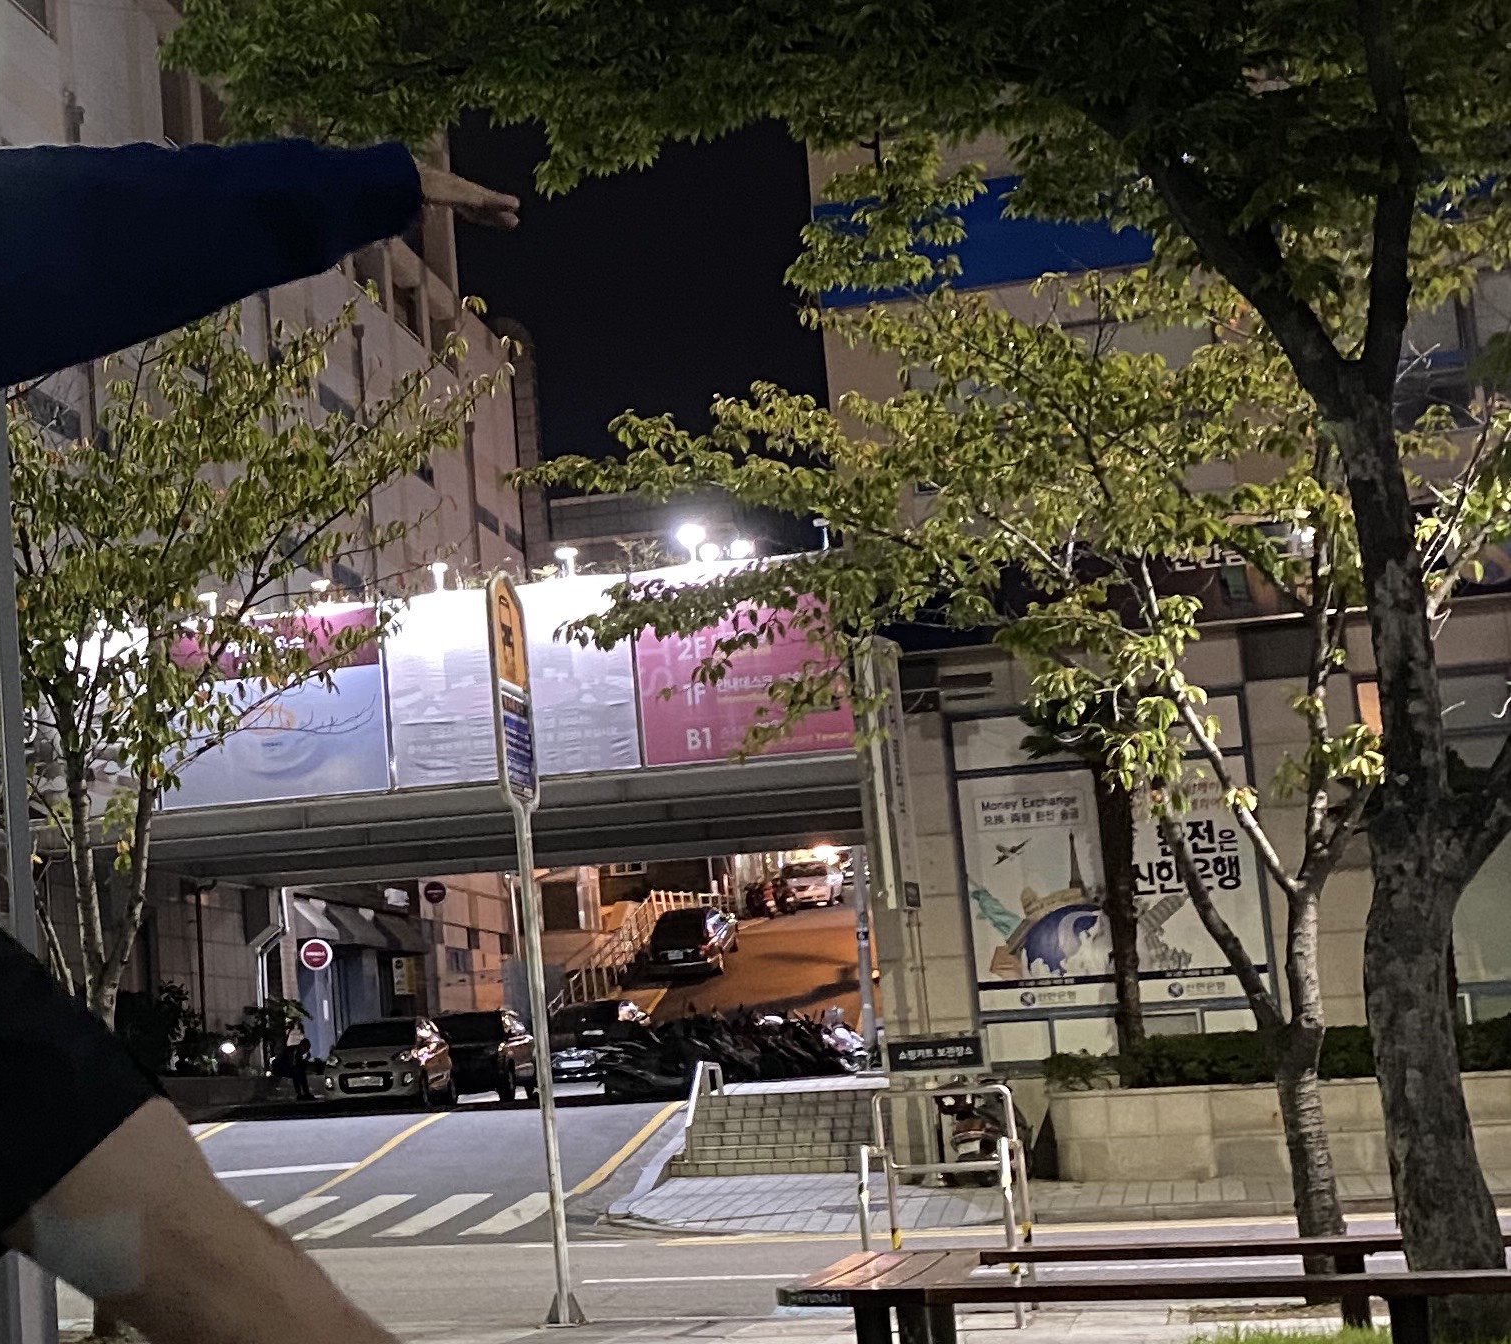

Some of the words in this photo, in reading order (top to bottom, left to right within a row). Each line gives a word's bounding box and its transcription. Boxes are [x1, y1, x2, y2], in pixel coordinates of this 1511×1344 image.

[677, 635, 707, 662] 2F
[682, 682, 707, 707] 1F
[685, 726, 713, 752] B1
[980, 799, 1018, 812] Money
[1021, 795, 1078, 810] Exchange
